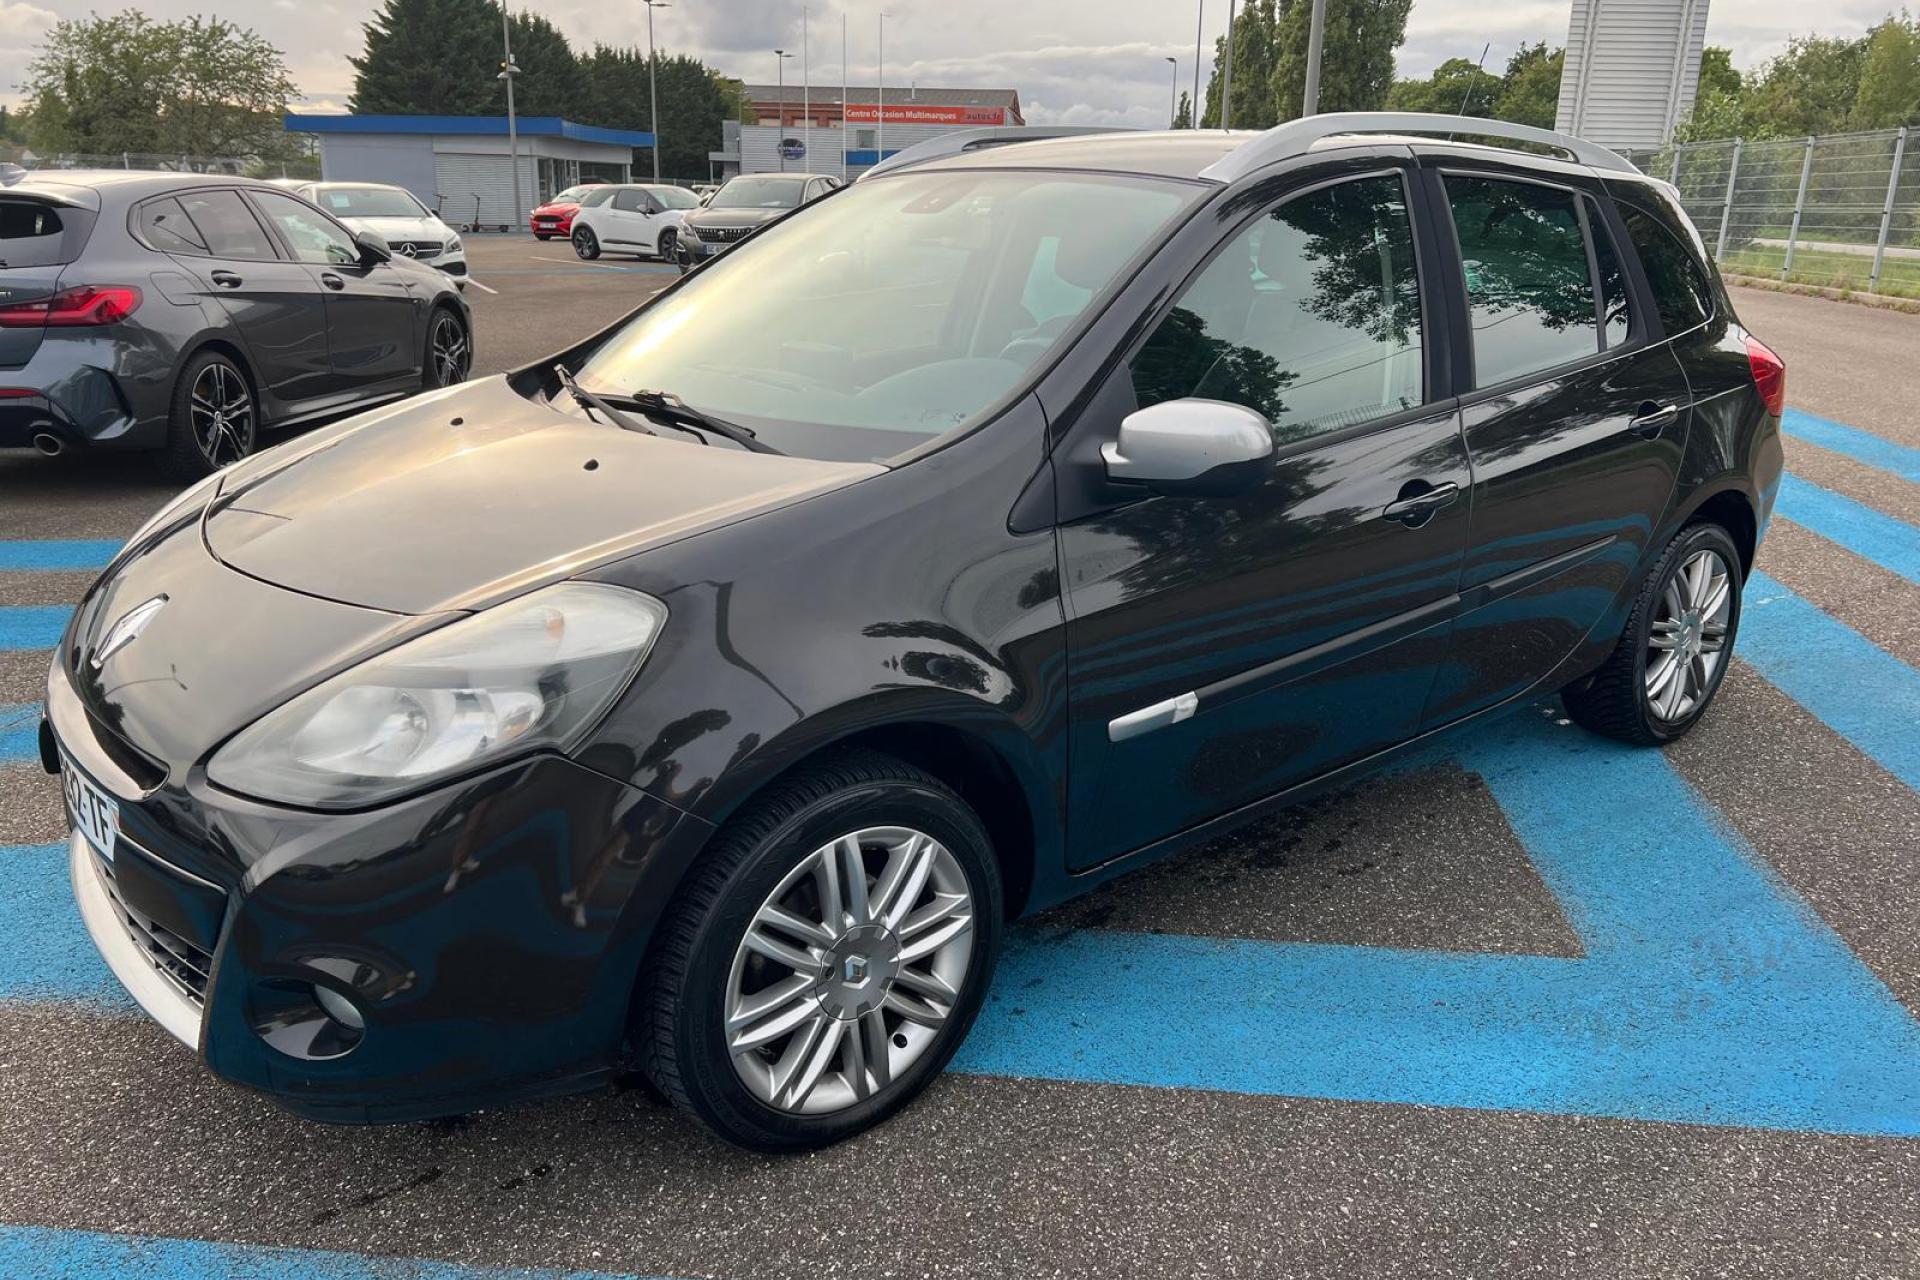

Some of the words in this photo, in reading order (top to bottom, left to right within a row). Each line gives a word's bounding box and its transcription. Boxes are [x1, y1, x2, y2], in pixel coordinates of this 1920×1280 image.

[846, 109, 870, 118] Centre
[871, 110, 904, 119] Occasion
[905, 111, 957, 121] Multimarques
